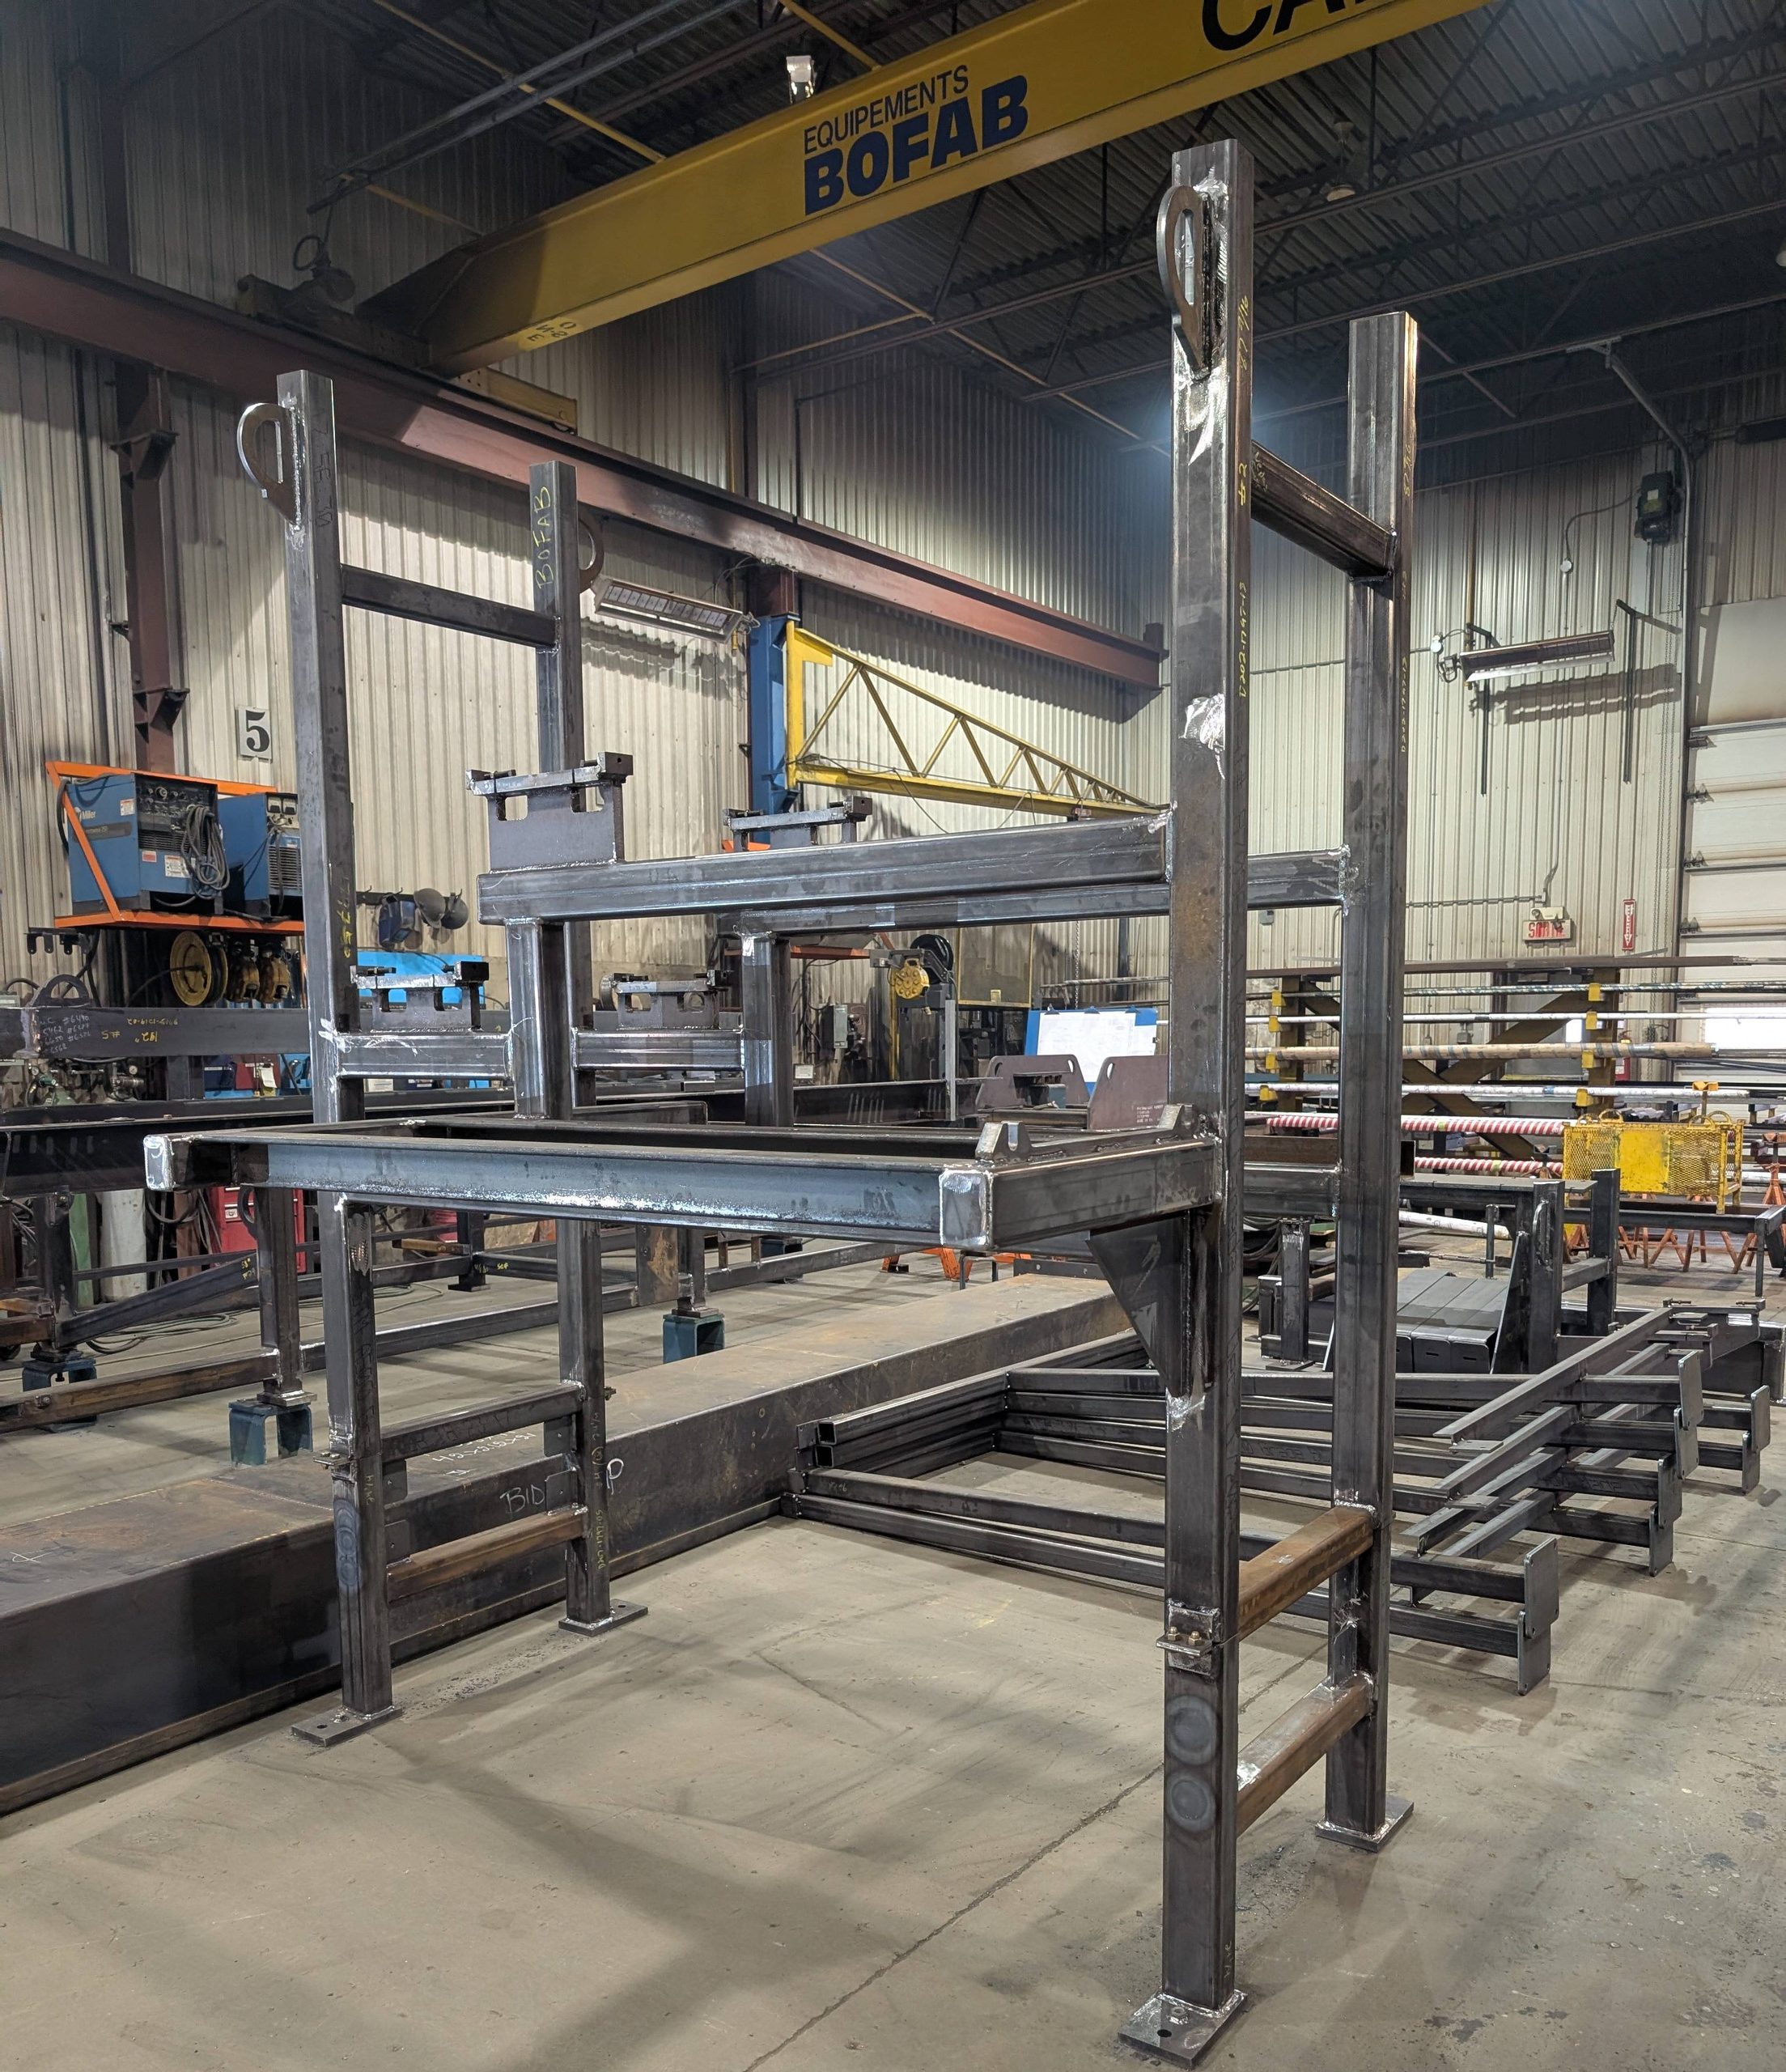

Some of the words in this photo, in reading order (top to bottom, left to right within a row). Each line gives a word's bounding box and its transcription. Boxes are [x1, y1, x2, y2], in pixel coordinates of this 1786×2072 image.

[804, 64, 969, 155] EQUIPEMENTS
[804, 74, 1029, 216] BOFAB
[532, 486, 554, 590] BOFAB
[245, 710, 271, 754] 5
[606, 1458, 624, 1495] P
